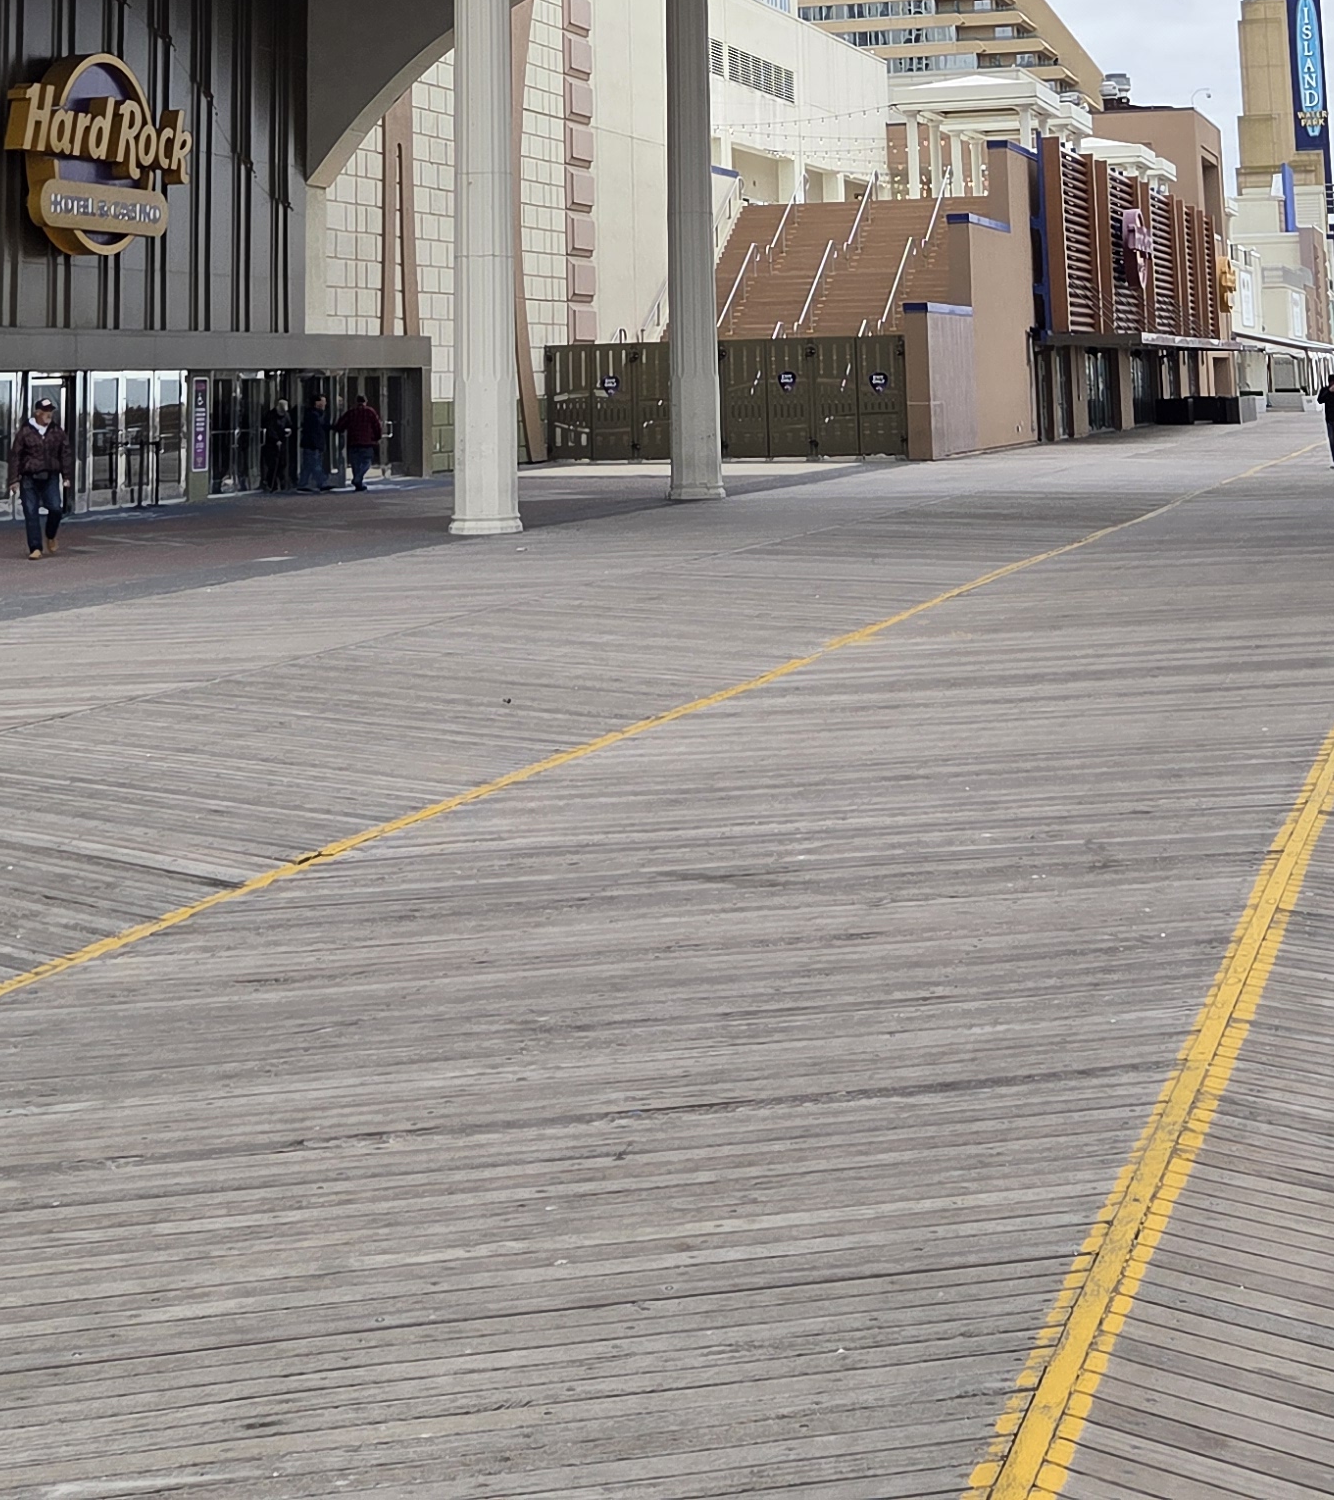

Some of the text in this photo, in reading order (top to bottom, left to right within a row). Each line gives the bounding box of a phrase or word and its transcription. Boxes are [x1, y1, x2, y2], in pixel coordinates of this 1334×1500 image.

[1302, 7, 1319, 107] ISLAND
[1297, 110, 1328, 120] WATER
[1301, 118, 1325, 127] PARK
[21, 82, 193, 185] Hard Rock
[50, 193, 96, 218] HOTEL
[110, 201, 162, 225] CASINO
